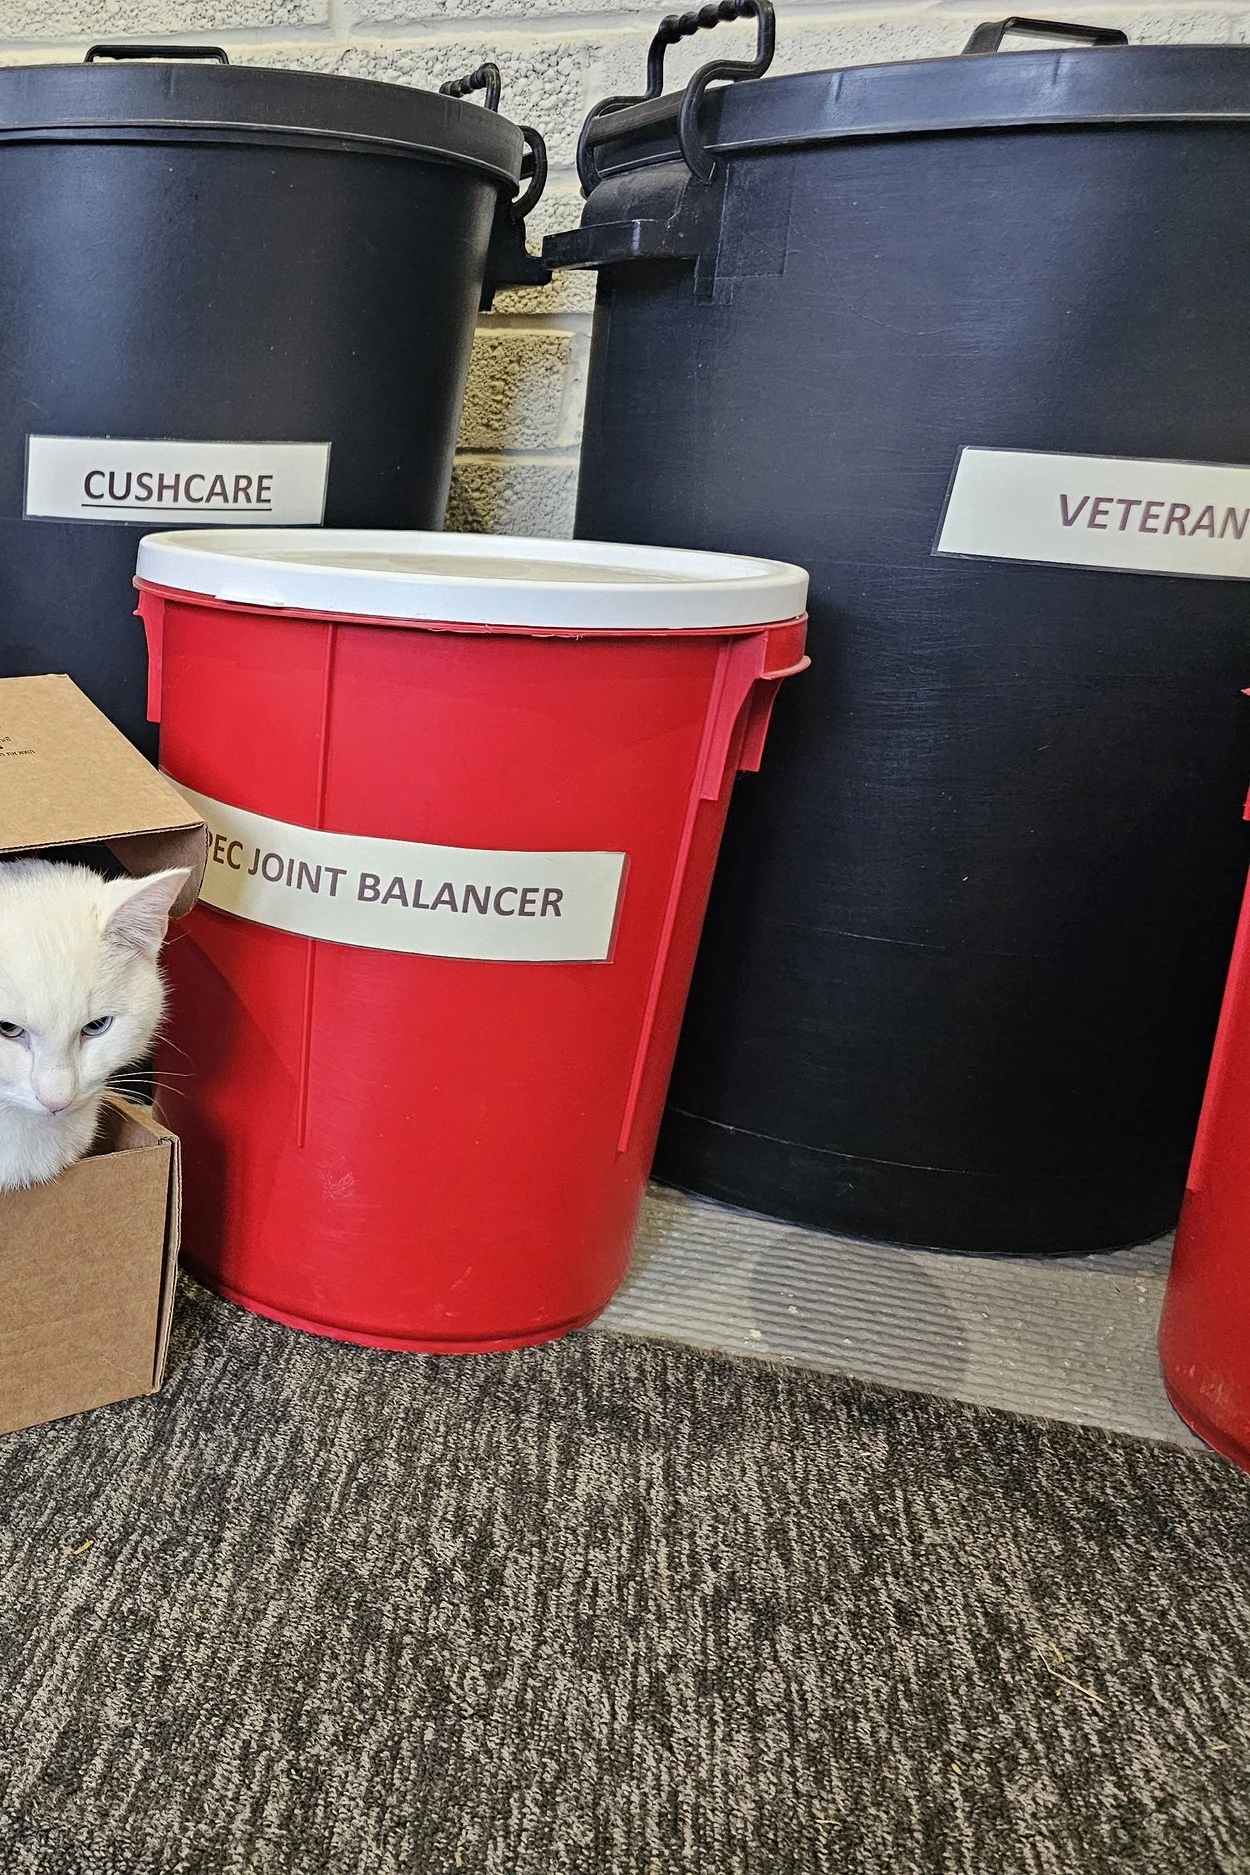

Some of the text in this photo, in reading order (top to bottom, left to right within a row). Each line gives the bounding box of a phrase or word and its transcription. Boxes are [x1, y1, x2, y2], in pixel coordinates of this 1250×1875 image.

[83, 470, 274, 504] CUSHCARE
[1059, 493, 1250, 541] VETERAN
[248, 848, 347, 897] JOINT
[357, 872, 564, 918] BALANCER
